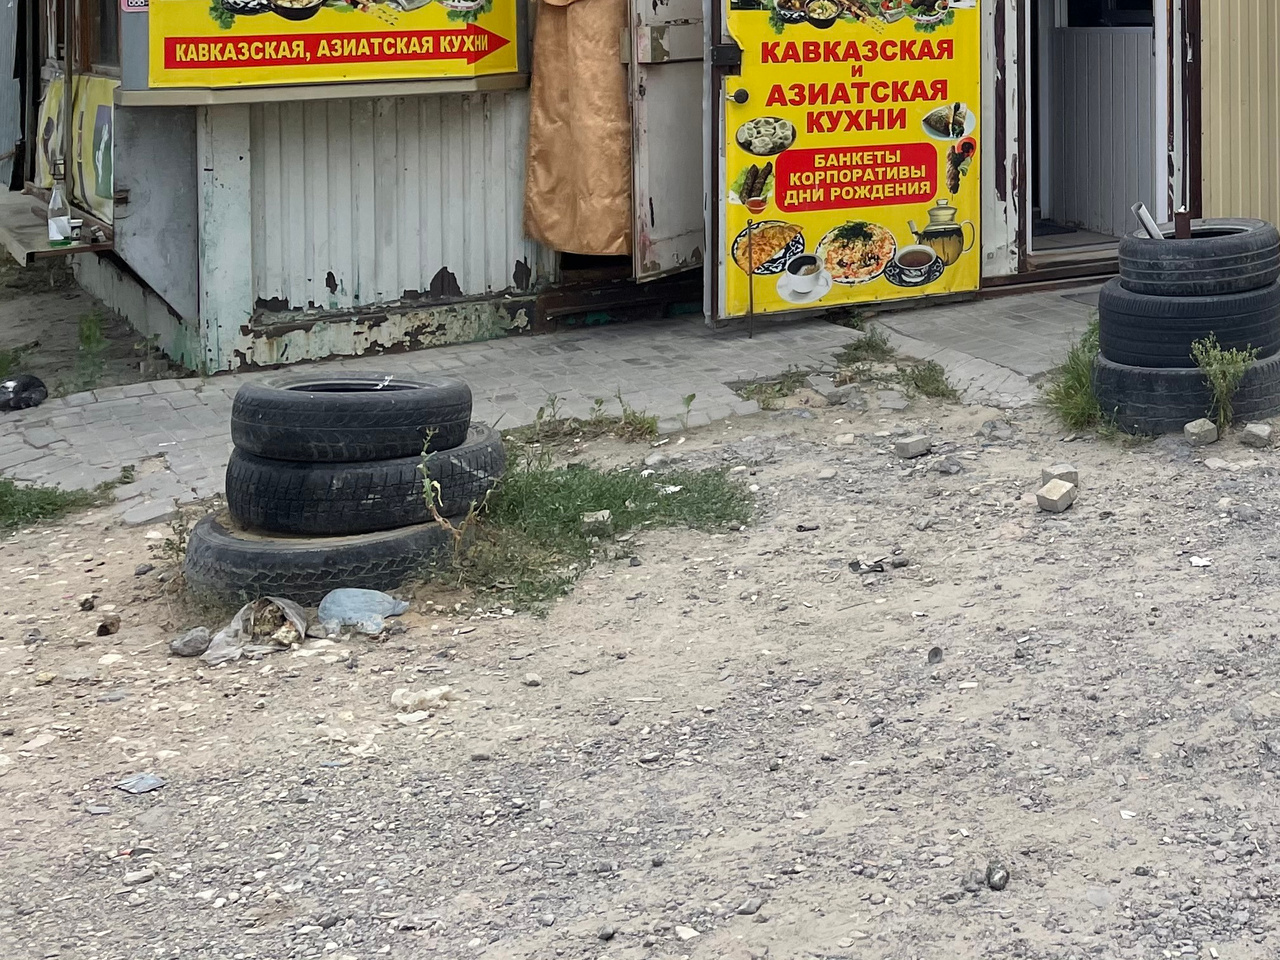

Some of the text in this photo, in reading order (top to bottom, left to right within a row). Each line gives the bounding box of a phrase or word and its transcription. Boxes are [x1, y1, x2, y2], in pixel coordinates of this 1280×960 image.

[175, 34, 489, 62] КАВКАЗСКАЯ, АЗИАТСКАЯ КУХНИ
[761, 39, 954, 64] КАВКАЗСКАЯ
[765, 79, 948, 107] АЗИАТСКАЯ
[806, 108, 907, 133] КУХНИ
[814, 150, 901, 168] БАНКЕТЫ
[789, 165, 926, 186] КОРПОРАТИВЫ
[784, 181, 931, 207] ДНИ РОЖДЕНИЯ
